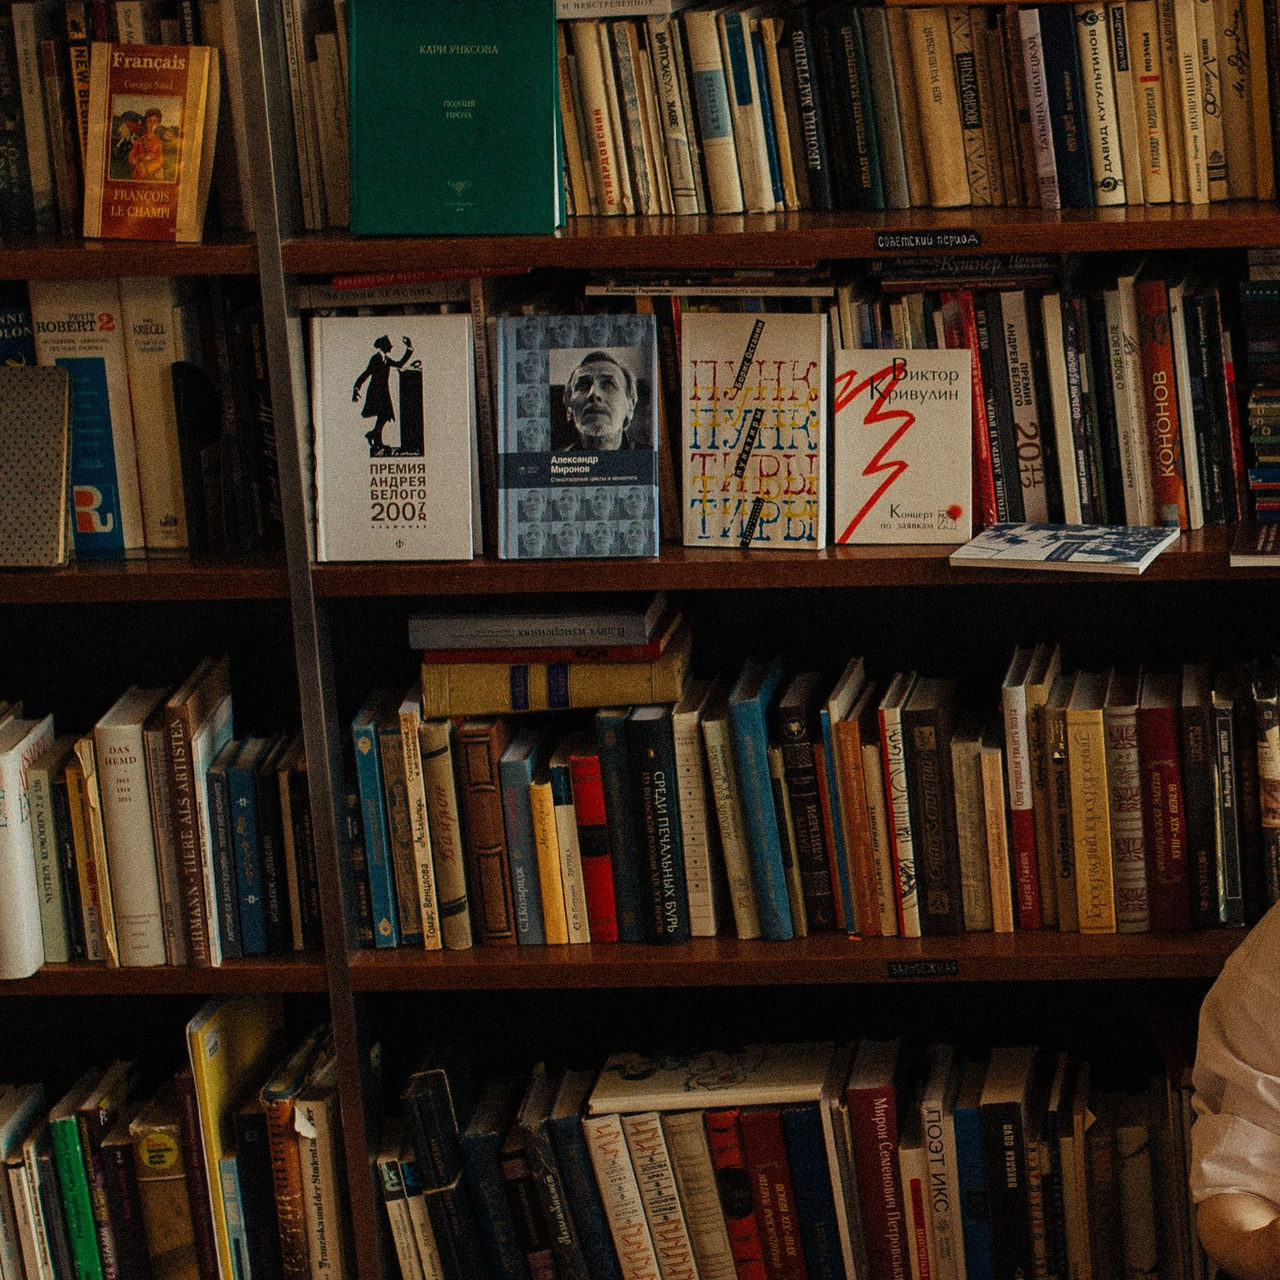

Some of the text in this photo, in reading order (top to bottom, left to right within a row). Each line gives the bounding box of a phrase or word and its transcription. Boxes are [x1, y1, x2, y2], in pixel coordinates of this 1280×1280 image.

[74, 48, 91, 84] NEW
[111, 51, 187, 71] Français
[791, 29, 822, 171] ЛЕОНИД МАРТЫНОВ
[1087, 28, 1114, 173] ДАВИД КУГУЛЬТИНОВ
[109, 204, 171, 219] LE CHAMPI
[113, 188, 171, 203] FRANÇOIS
[35, 312, 116, 334] ROBERT 2
[892, 356, 960, 386] Виктор
[1006, 322, 1024, 407] АНДРЕЯ БЕЛОГО
[869, 376, 960, 405] Кривулин
[1020, 361, 1033, 406] ПРЕМИЯ
[1152, 370, 1176, 477] КОНОНОВ
[369, 462, 427, 475] ПРЕМИЯ
[369, 475, 427, 489] АНДРЕЯ
[370, 488, 427, 501] БЕЛОГО
[889, 503, 934, 519] Концерт
[104, 756, 138, 767] HEMD
[108, 744, 131, 756] DAS
[167, 718, 208, 961] LEHMANN TIERE ALS ARTISTEN
[651, 770, 681, 934] СРЕДИ ПЕЧАЛЬНЫХ БУРЬ
[418, 863, 436, 940] Томас Венцлова
[870, 1096, 889, 1139] Мирон
[876, 1140, 898, 1209] Семенович
[926, 1108, 949, 1213] ПОЭТ ИКС
